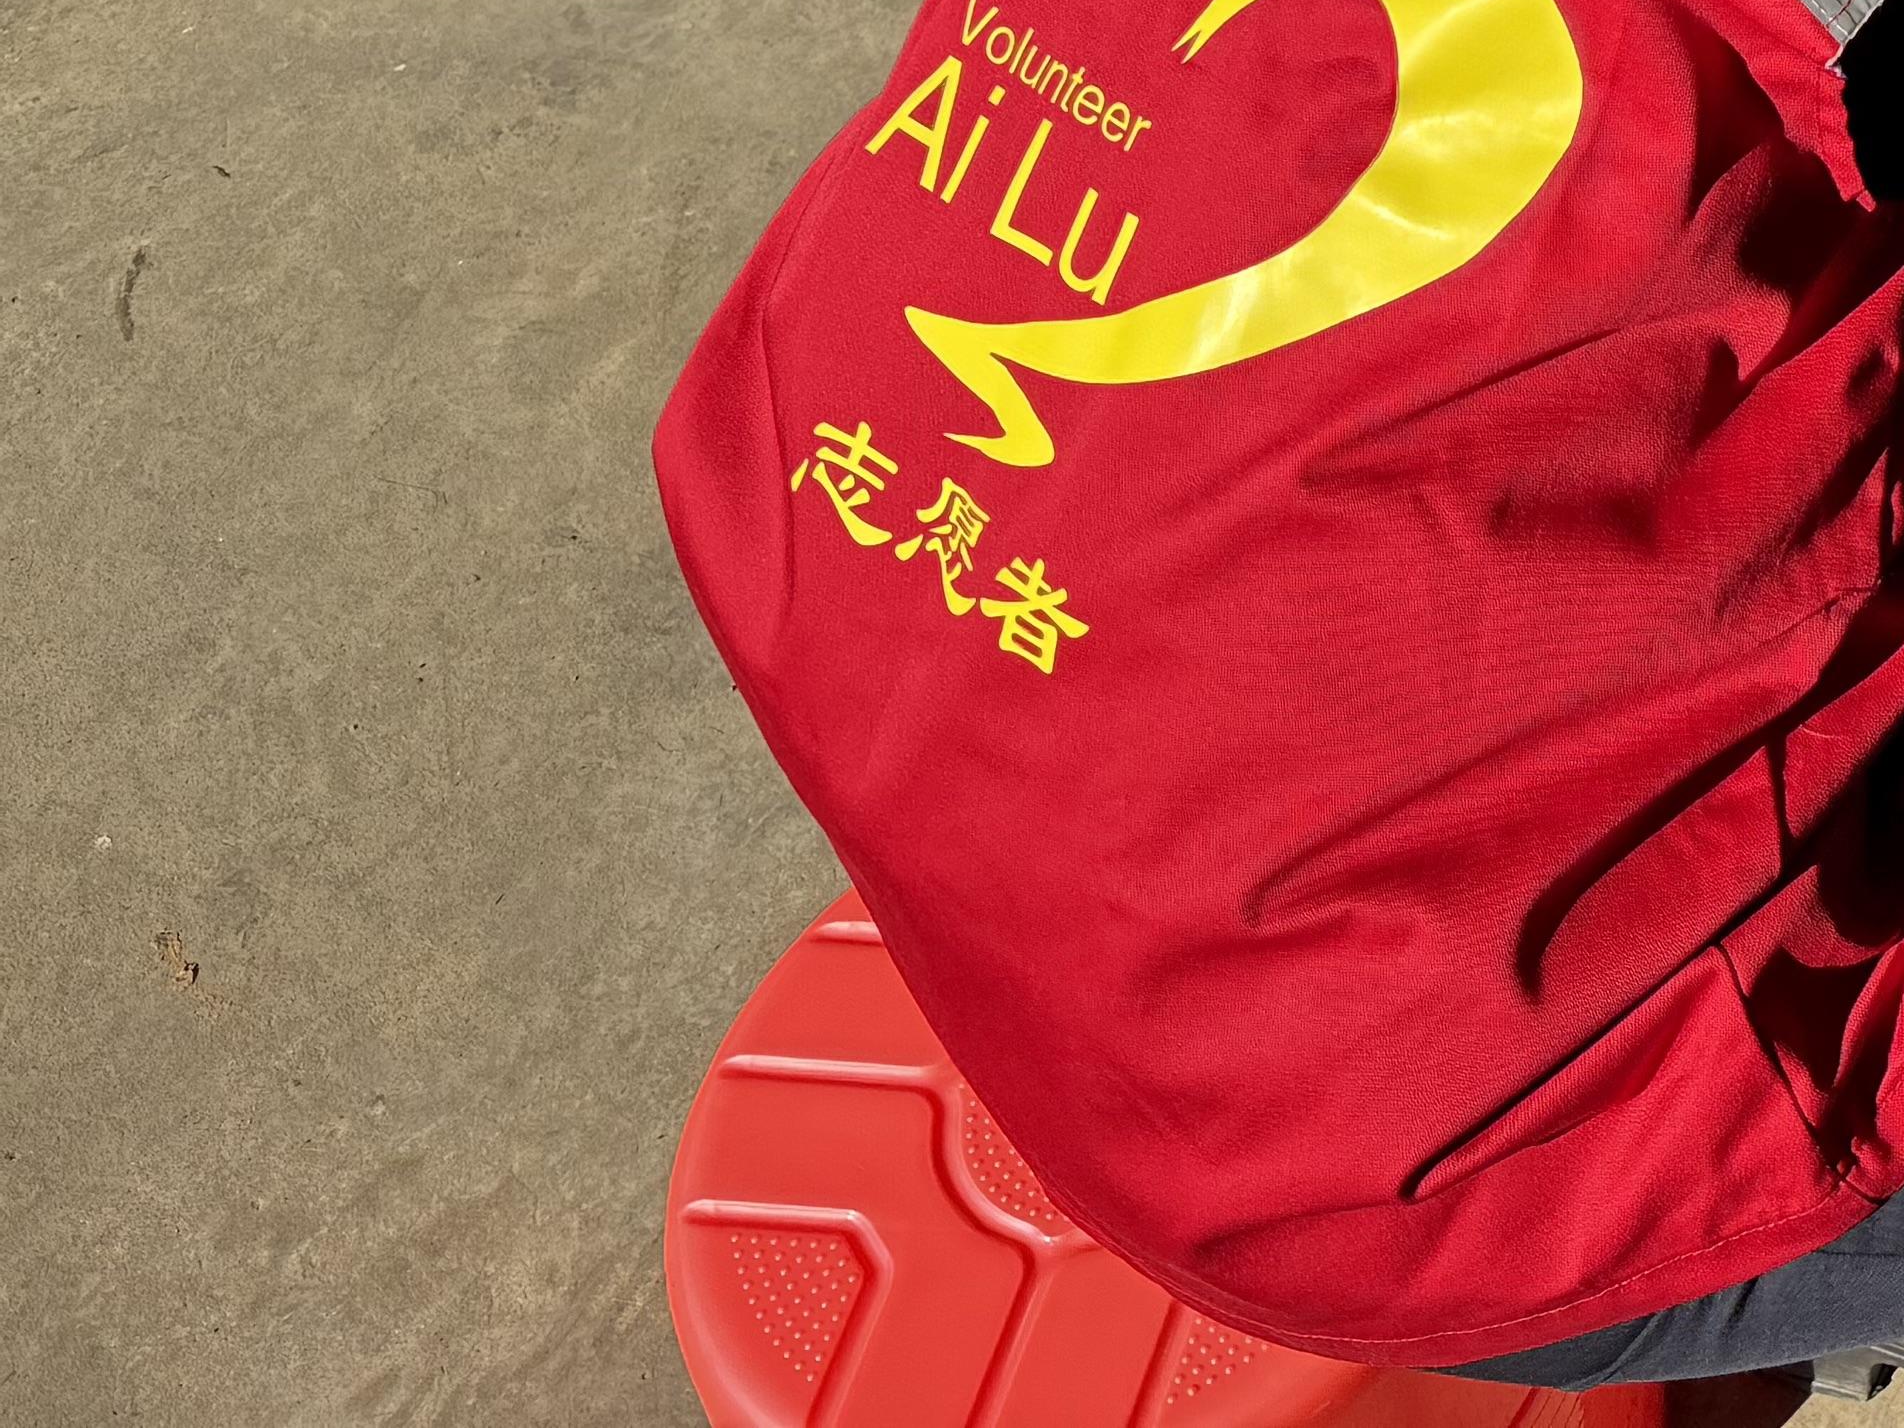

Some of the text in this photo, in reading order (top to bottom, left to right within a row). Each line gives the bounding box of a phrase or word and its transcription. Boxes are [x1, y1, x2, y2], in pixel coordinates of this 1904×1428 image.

[864, 55, 1140, 306] Ai Lu
[790, 420, 1090, 674] 志愿者
